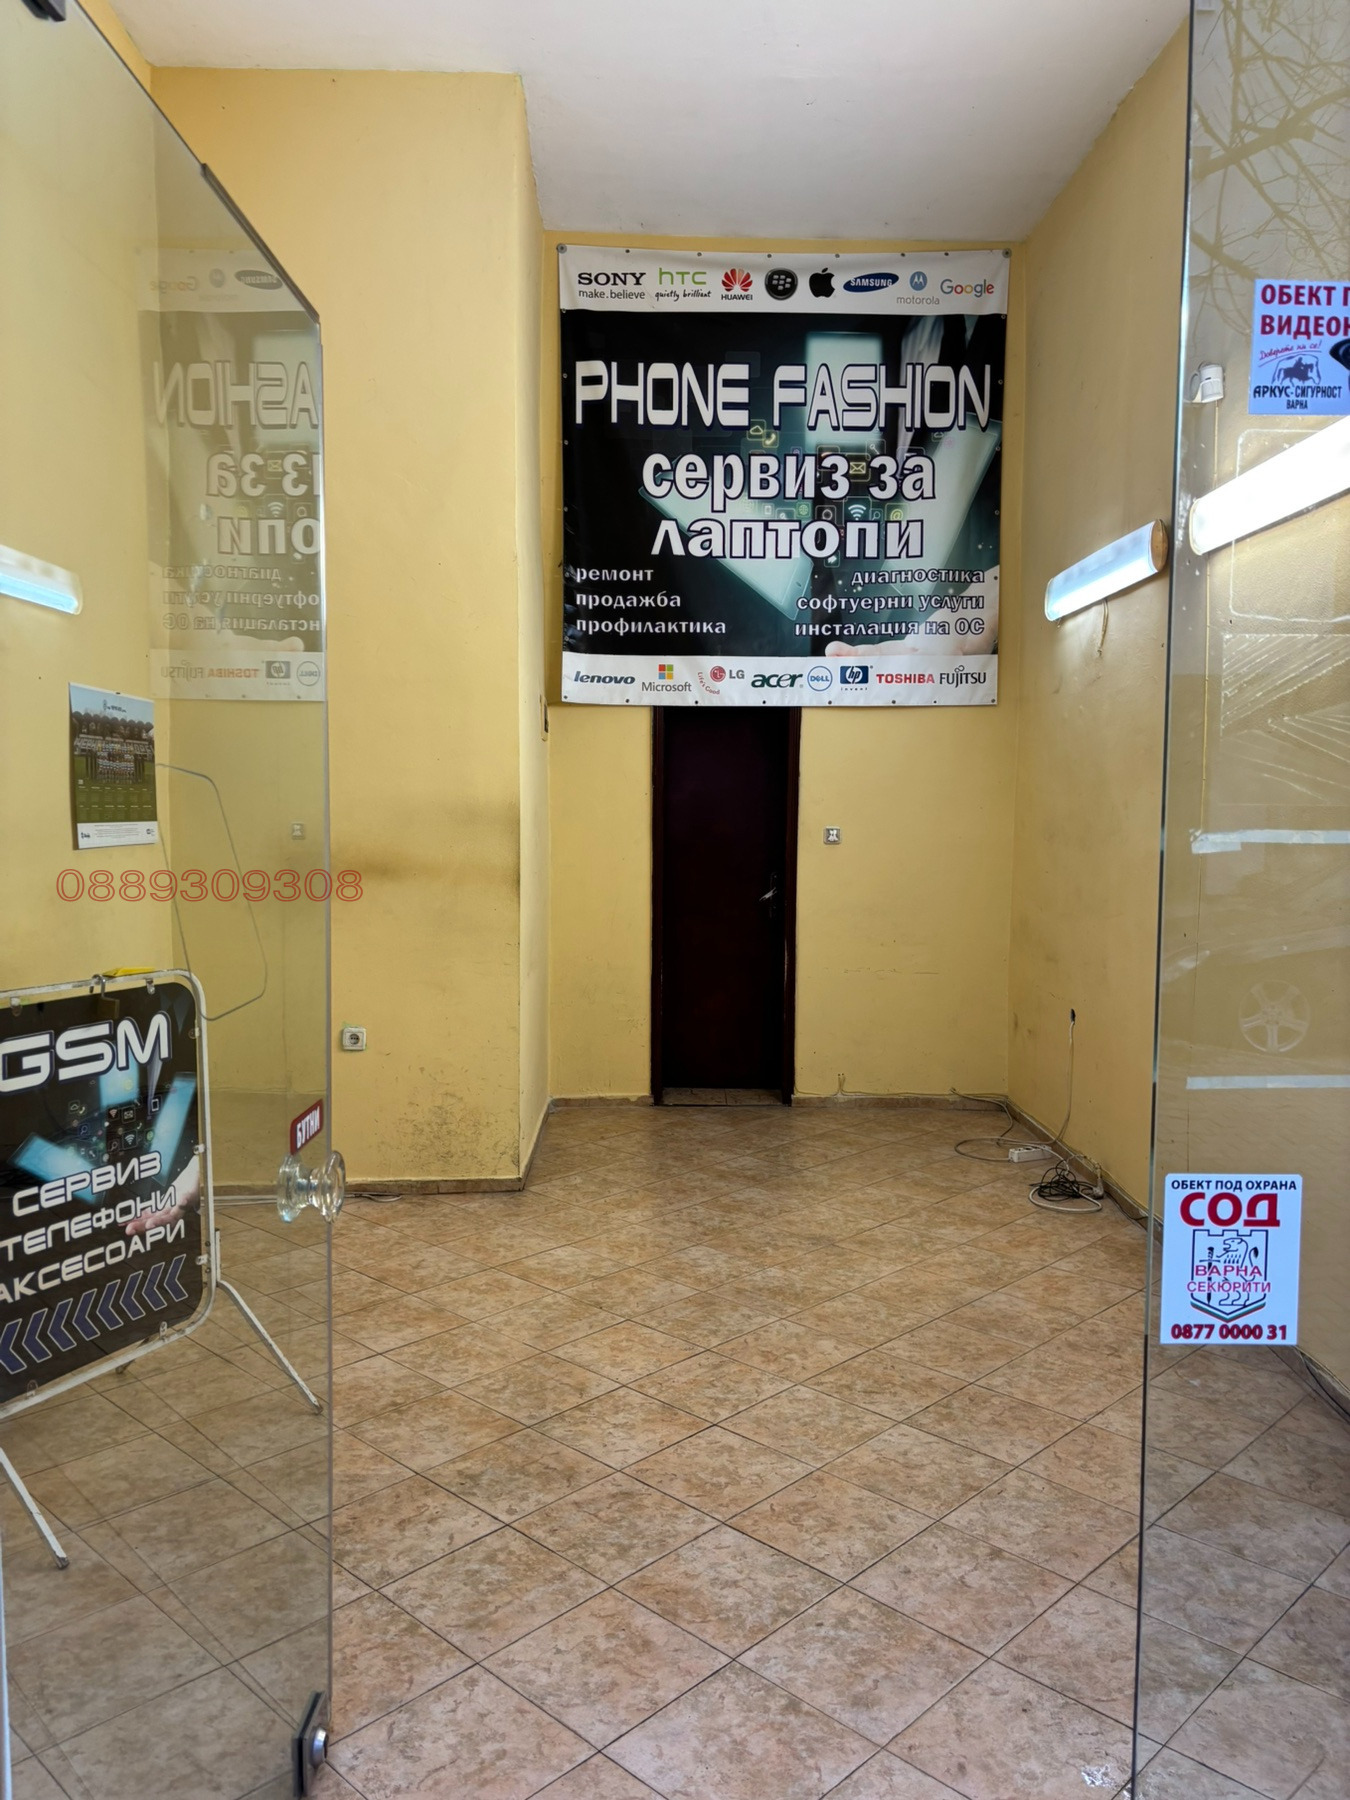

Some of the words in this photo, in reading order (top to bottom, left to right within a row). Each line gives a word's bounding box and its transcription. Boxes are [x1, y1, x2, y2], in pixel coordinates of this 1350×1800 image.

[577, 272, 646, 286] SONY
[850, 278, 893, 288] SAMSUNG
[578, 289, 645, 300] make.believe
[655, 289, 680, 302] quietly
[683, 289, 712, 298] brilliant
[940, 278, 995, 298] Google
[1261, 284, 1337, 306] ОБЕКТ
[896, 295, 940, 305] motorola
[575, 360, 752, 430] PHONE
[773, 362, 992, 432] FASHION
[1286, 400, 1309, 410] ВАРНА
[642, 452, 852, 513] сервиз
[867, 453, 937, 501] за
[650, 517, 926, 560] лаптопи
[576, 567, 654, 583] ремонт
[851, 568, 985, 586] диагностика
[576, 590, 682, 610] продажба
[796, 594, 914, 614] софтуерни
[919, 594, 985, 614] услуги
[576, 617, 727, 637] профилактика
[794, 620, 920, 638] инсталация
[924, 620, 950, 635] на
[954, 617, 986, 635] ОС
[574, 670, 636, 685] lenovo
[729, 669, 745, 679] LG
[751, 673, 804, 689] acer
[810, 675, 830, 683] DELL
[845, 666, 860, 682] hp
[876, 673, 935, 684] TOSHIBA
[939, 665, 987, 688] FUJITSU
[641, 681, 692, 693] Microsoft
[705, 685, 721, 695] Good
[0, 1012, 171, 1094] GSM
[12, 1151, 162, 1218] СЕРВИЗ
[1171, 1180, 1212, 1190] ОБЕКТ
[1215, 1180, 1243, 1192] ПОД
[1245, 1180, 1297, 1191] ОХРАНА
[1179, 1192, 1281, 1227] СОД
[0, 1185, 177, 1262] ТЕЛЕФОНИ
[0, 1218, 186, 1304] АКСЕСОАРИ
[1195, 1265, 1263, 1277] ВАРНА
[1186, 1281, 1272, 1293] СЕКЮРИТИ
[1171, 1324, 1215, 1339] 0877
[1219, 1324, 1264, 1340] 0000
[1267, 1325, 1287, 1340] 31
